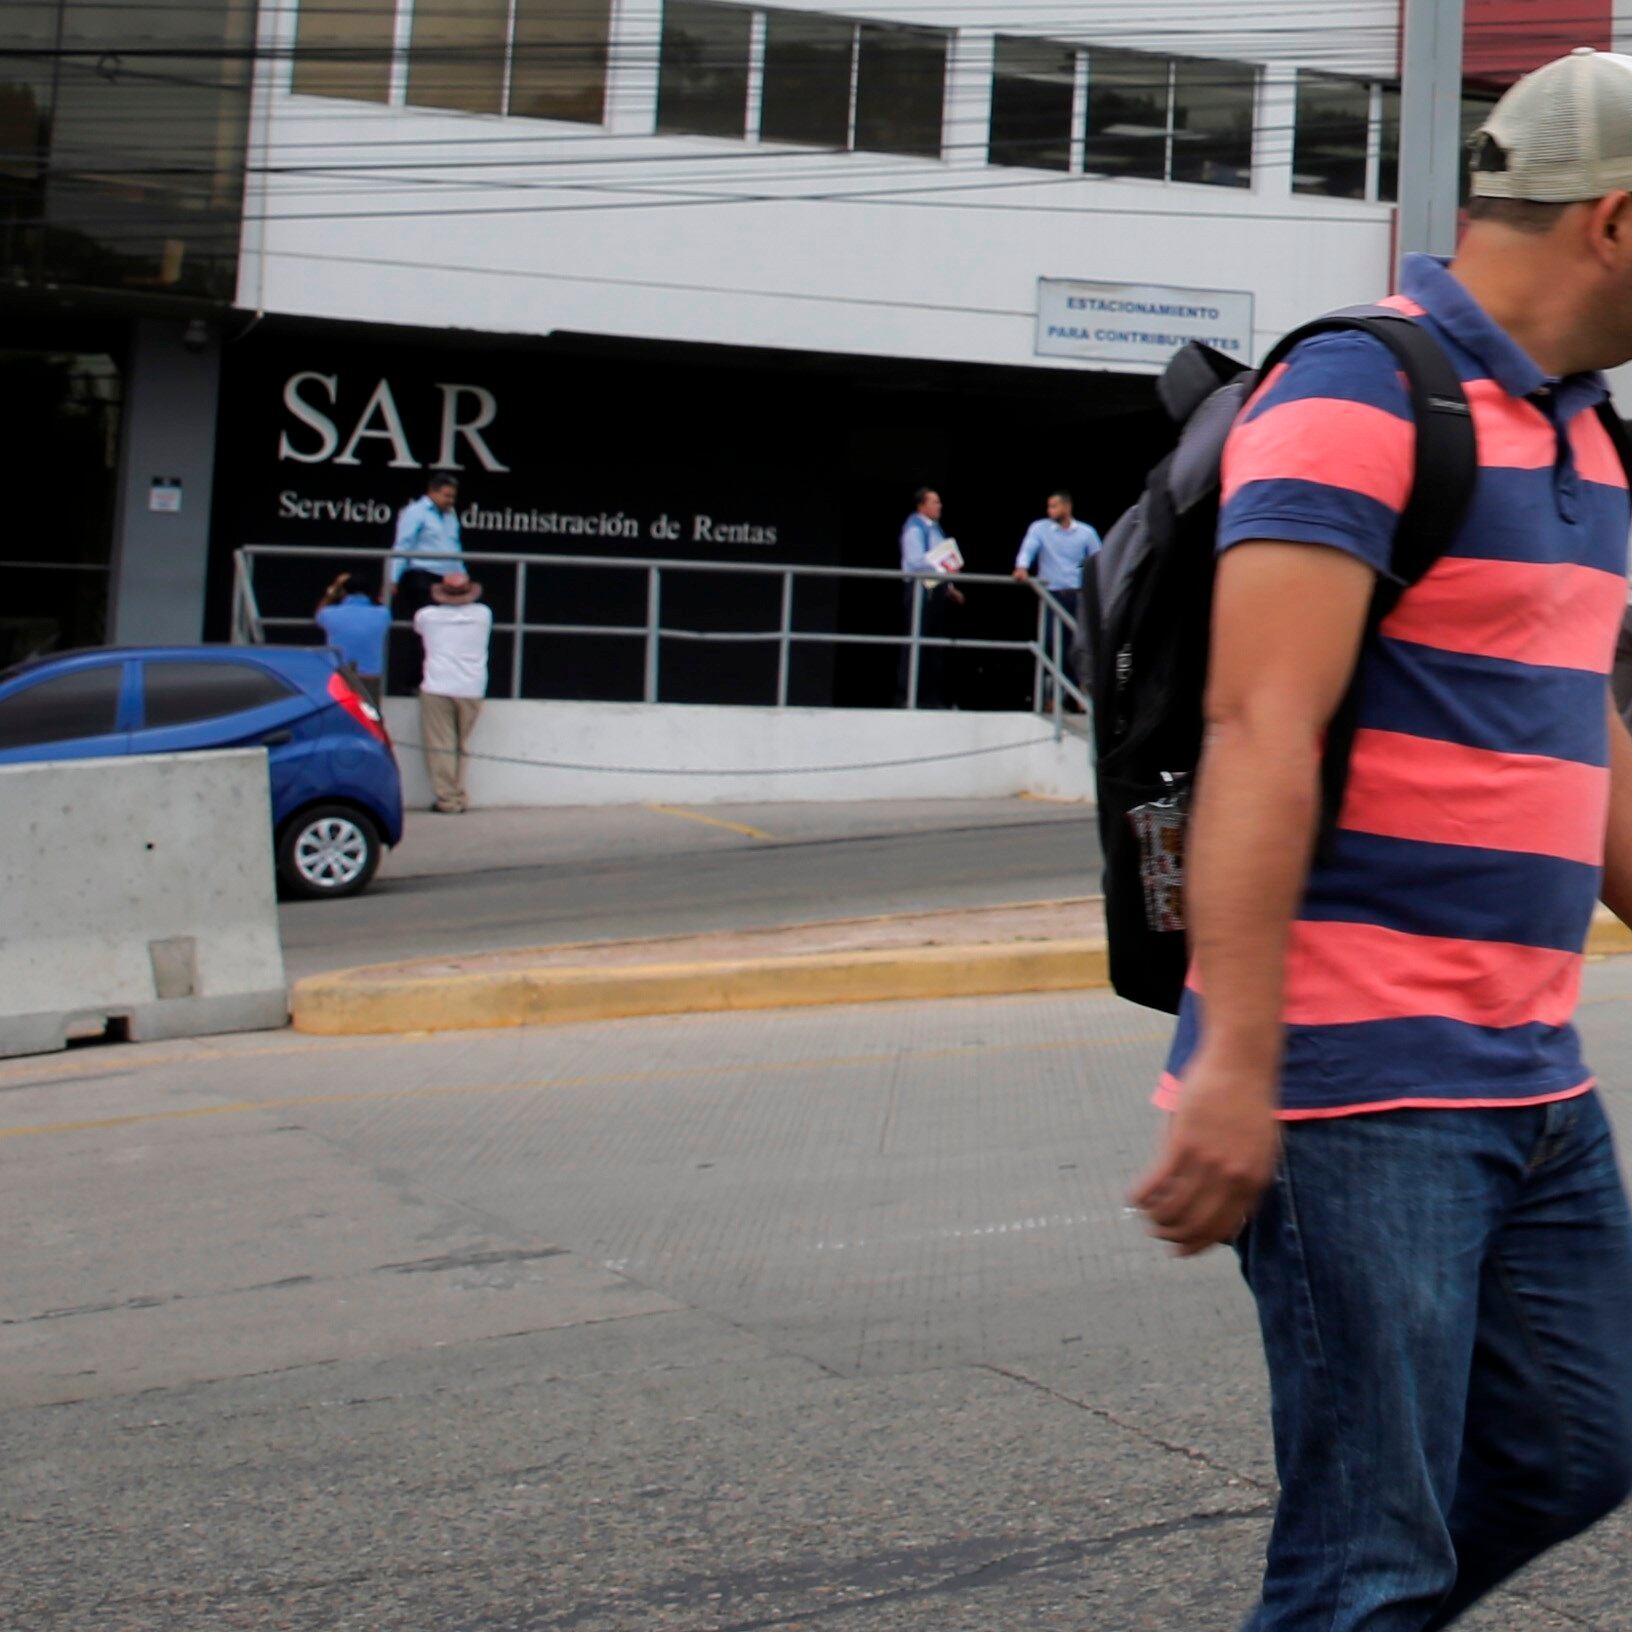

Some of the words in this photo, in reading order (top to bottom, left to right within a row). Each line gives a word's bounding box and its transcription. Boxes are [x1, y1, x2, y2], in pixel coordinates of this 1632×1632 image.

[1066, 296, 1220, 320] ESTACIONAMIENTO
[1048, 325, 1090, 340] PARA
[1094, 328, 1240, 351] CONTRIBUYNTES
[278, 371, 510, 472] SAR
[279, 490, 391, 523] Servicio
[461, 501, 639, 538] dministración
[650, 513, 681, 540] de
[692, 514, 777, 545] Rentas
